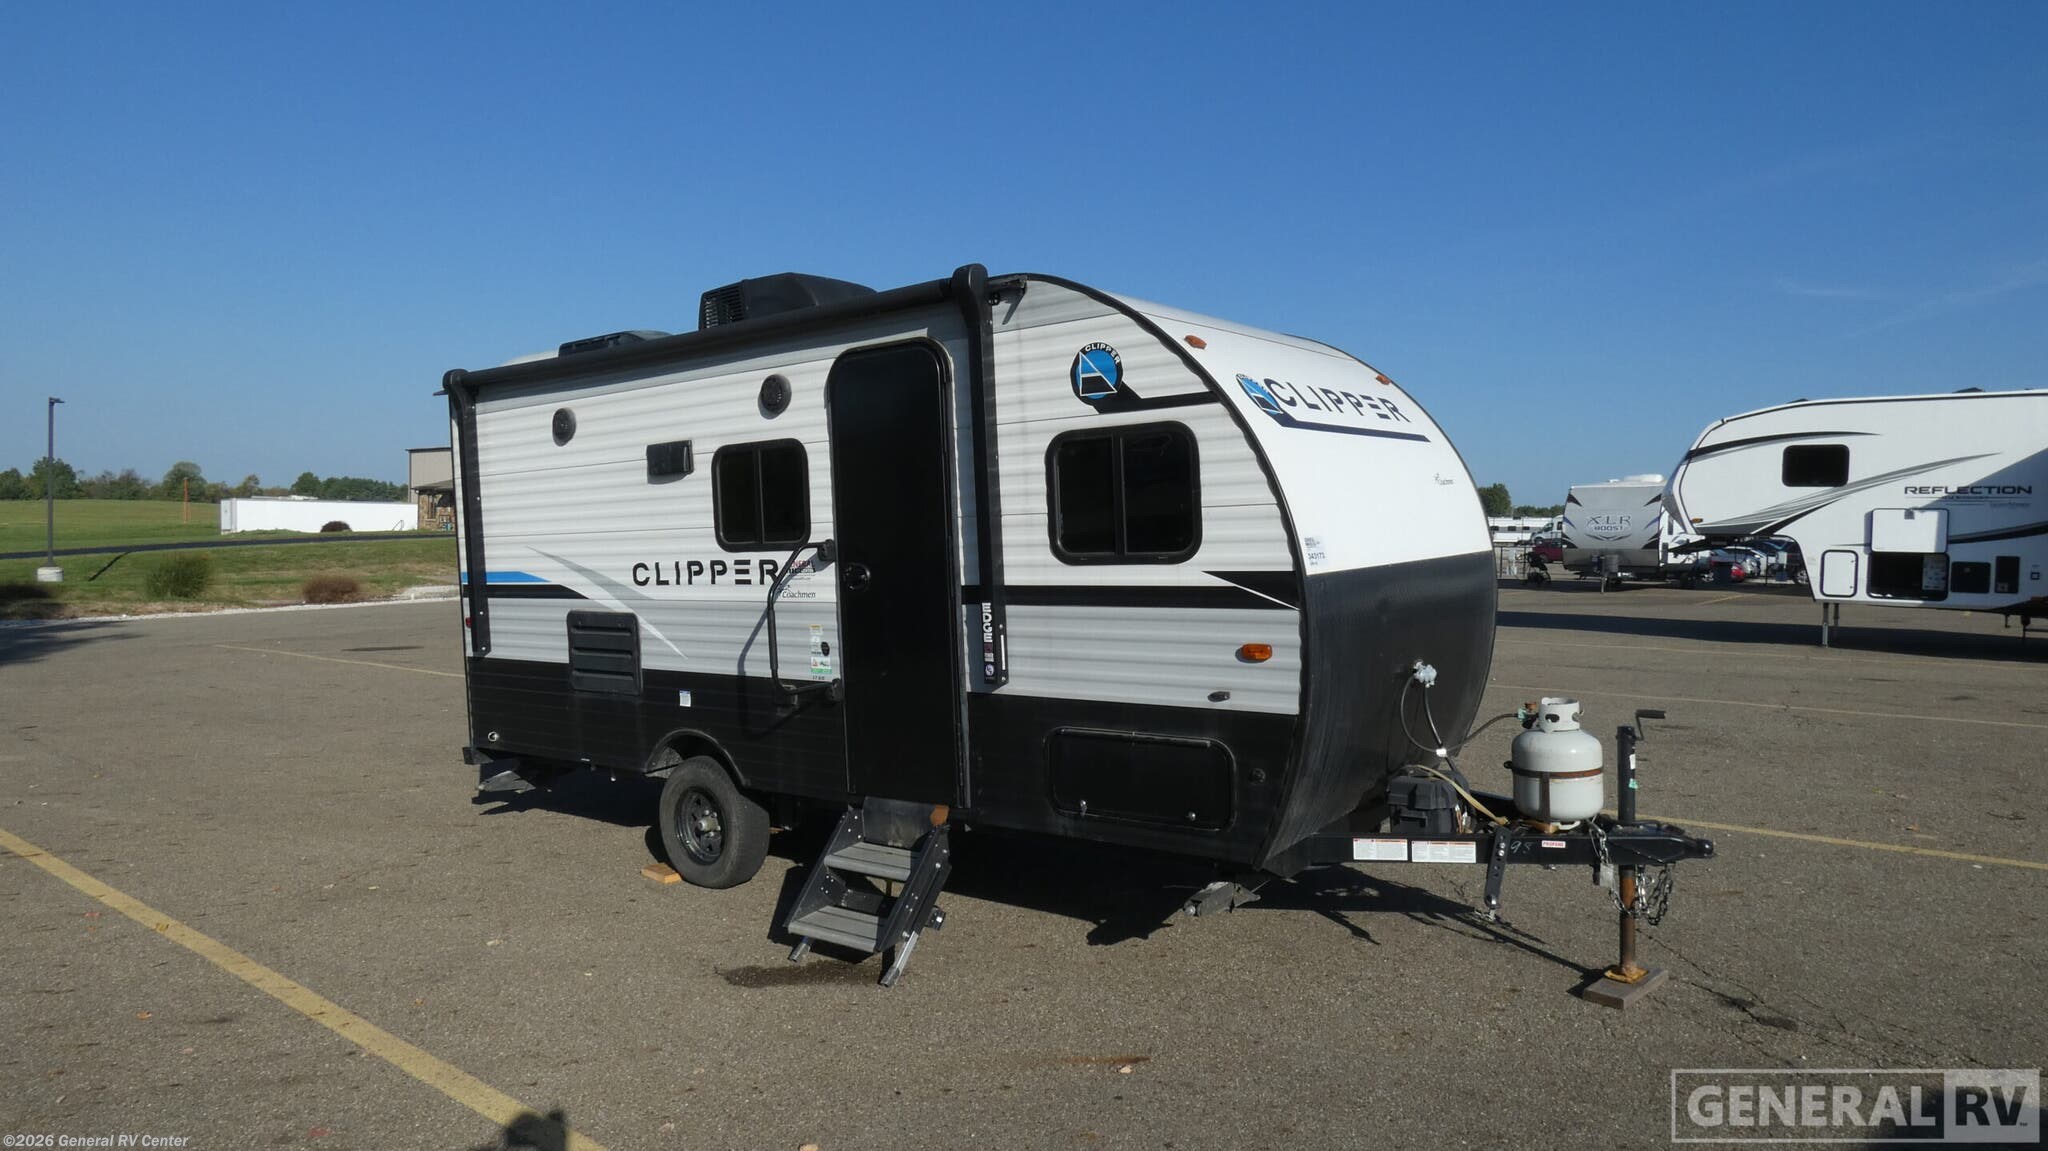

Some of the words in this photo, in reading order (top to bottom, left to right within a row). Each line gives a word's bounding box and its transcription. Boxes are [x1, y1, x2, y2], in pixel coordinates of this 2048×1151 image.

[1085, 343, 1121, 365] CLIPPER
[1263, 378, 1412, 424] CLIPPER
[1904, 486, 2033, 495] REFLECTION
[1587, 515, 1632, 526] XLR
[632, 559, 778, 587] CLIPPER
[781, 589, 816, 599] Coachmen
[981, 602, 993, 643] EDGE
